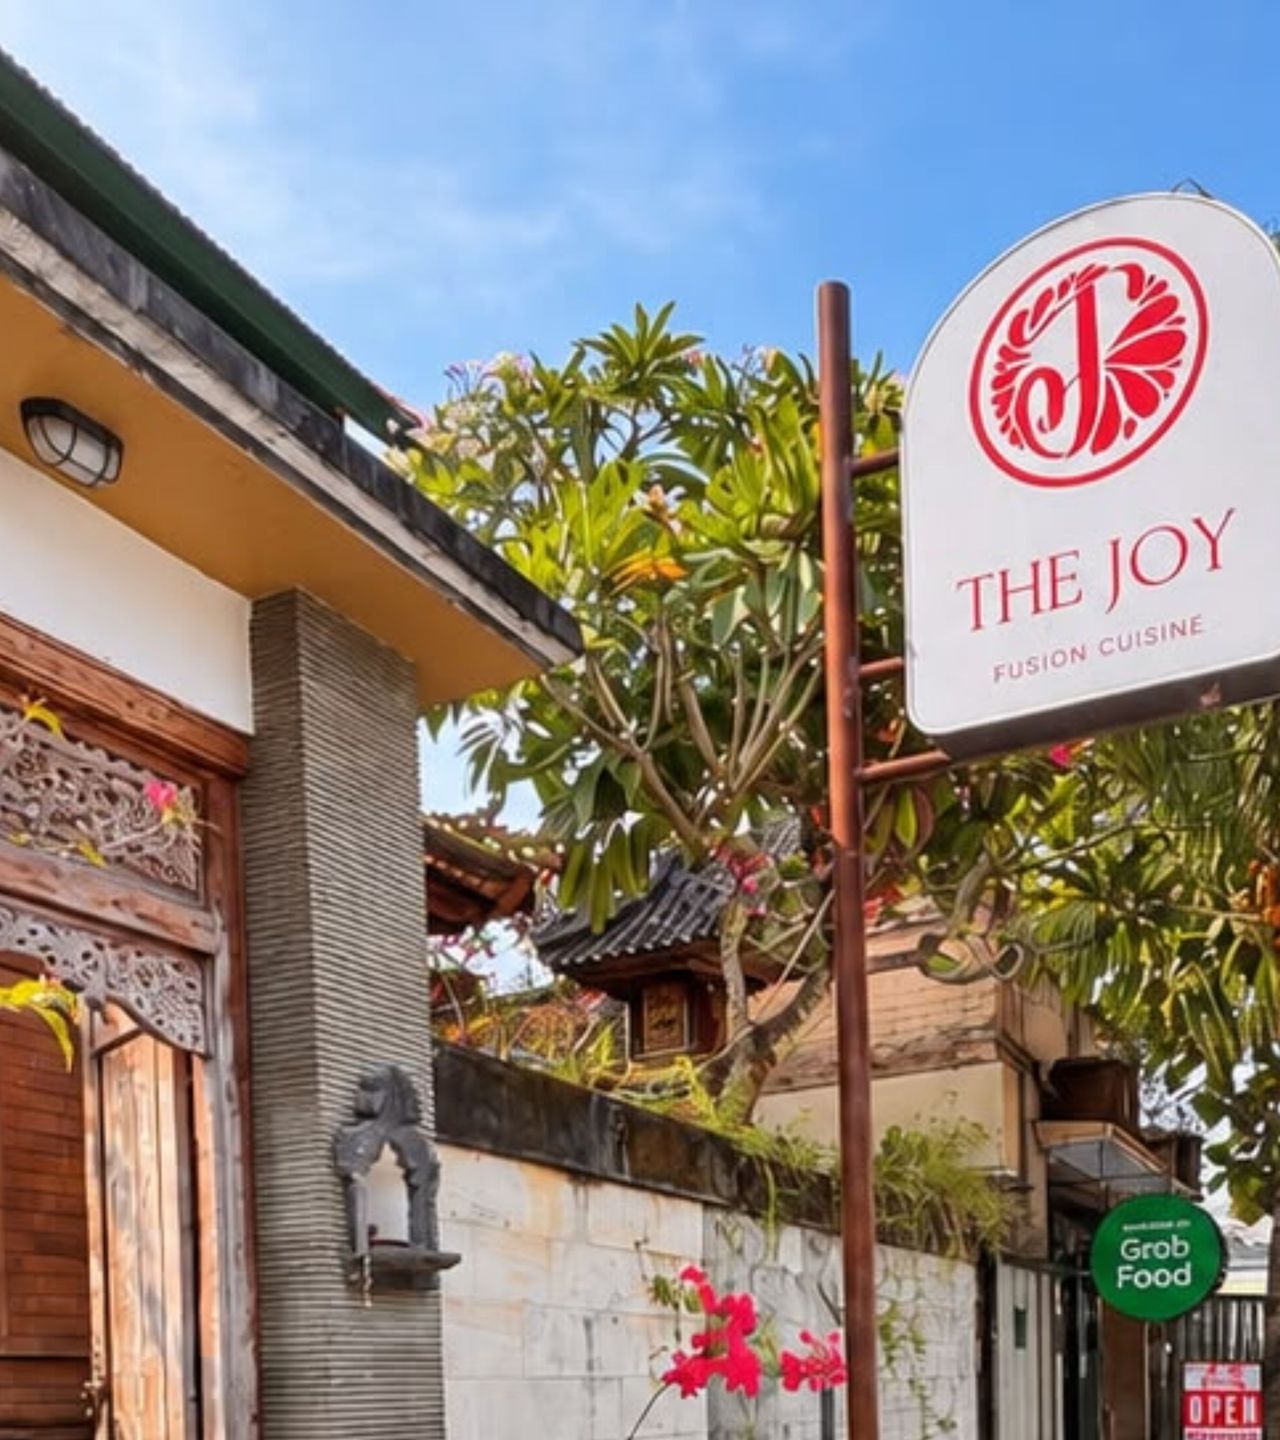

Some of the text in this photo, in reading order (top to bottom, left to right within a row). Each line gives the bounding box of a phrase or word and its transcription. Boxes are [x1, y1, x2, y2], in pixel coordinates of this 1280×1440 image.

[955, 507, 1236, 632] THE JOY
[993, 614, 1204, 683] FUSION CUISINE
[1117, 1261, 1192, 1289] Food
[1190, 1395, 1256, 1425] OPEN
